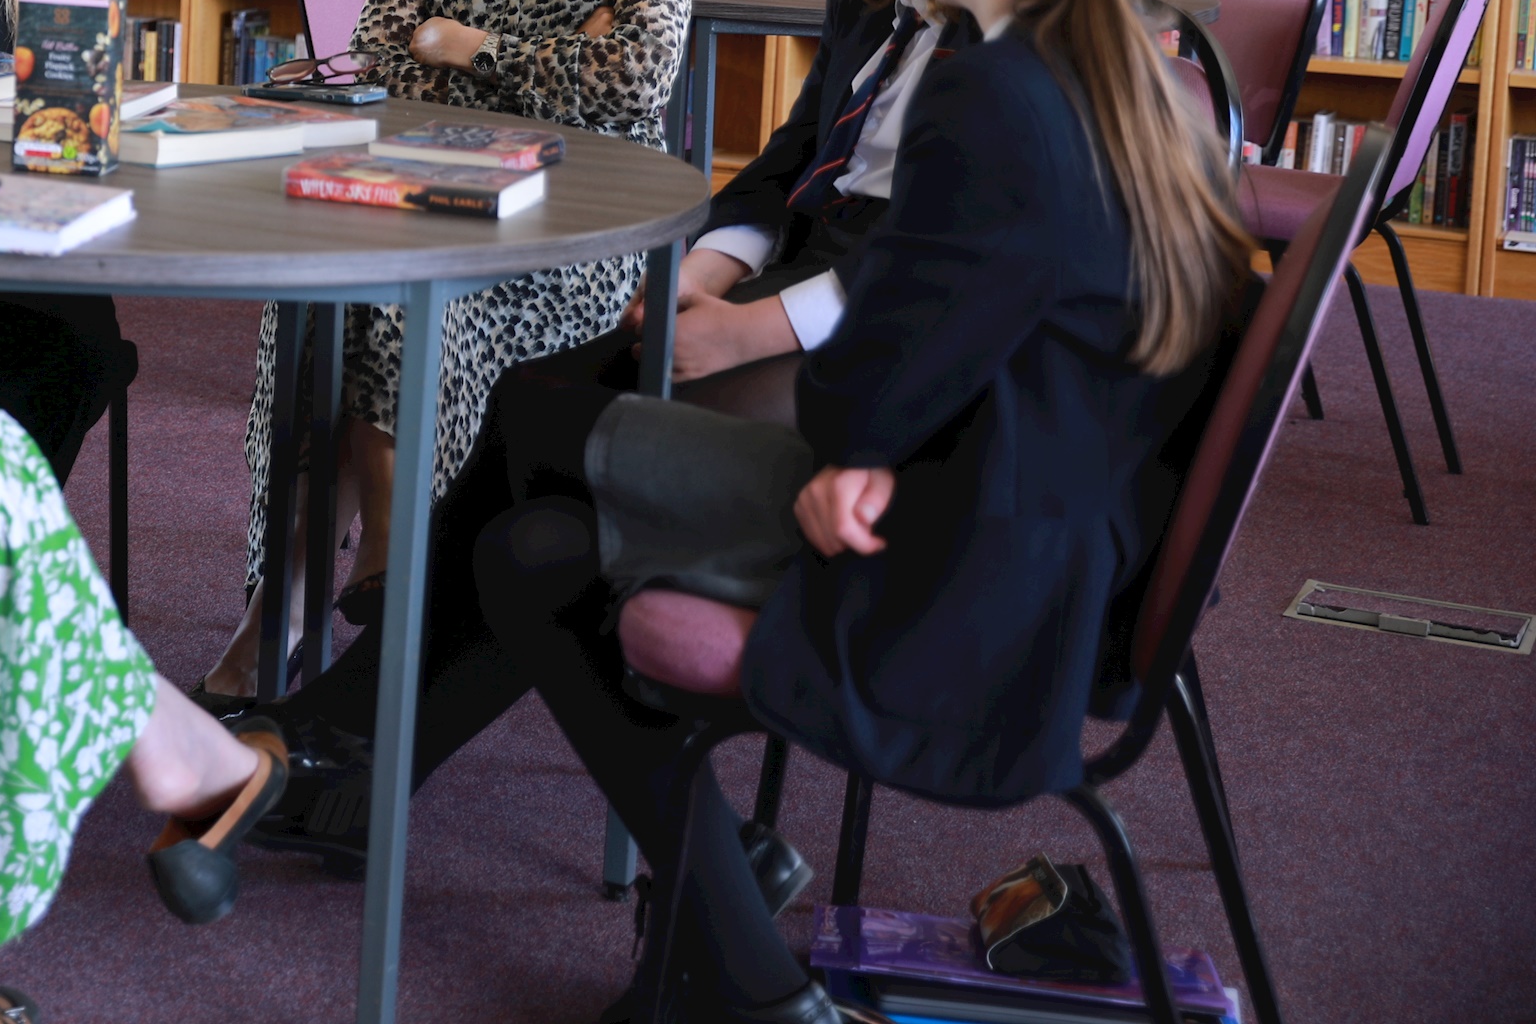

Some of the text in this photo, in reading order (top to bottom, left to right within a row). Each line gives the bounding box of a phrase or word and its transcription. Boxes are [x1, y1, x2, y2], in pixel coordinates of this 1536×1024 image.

[300, 178, 335, 198] WHEN
[345, 182, 373, 200] SKY
[429, 194, 450, 206] PHIL
[452, 196, 485, 209] EARLE
